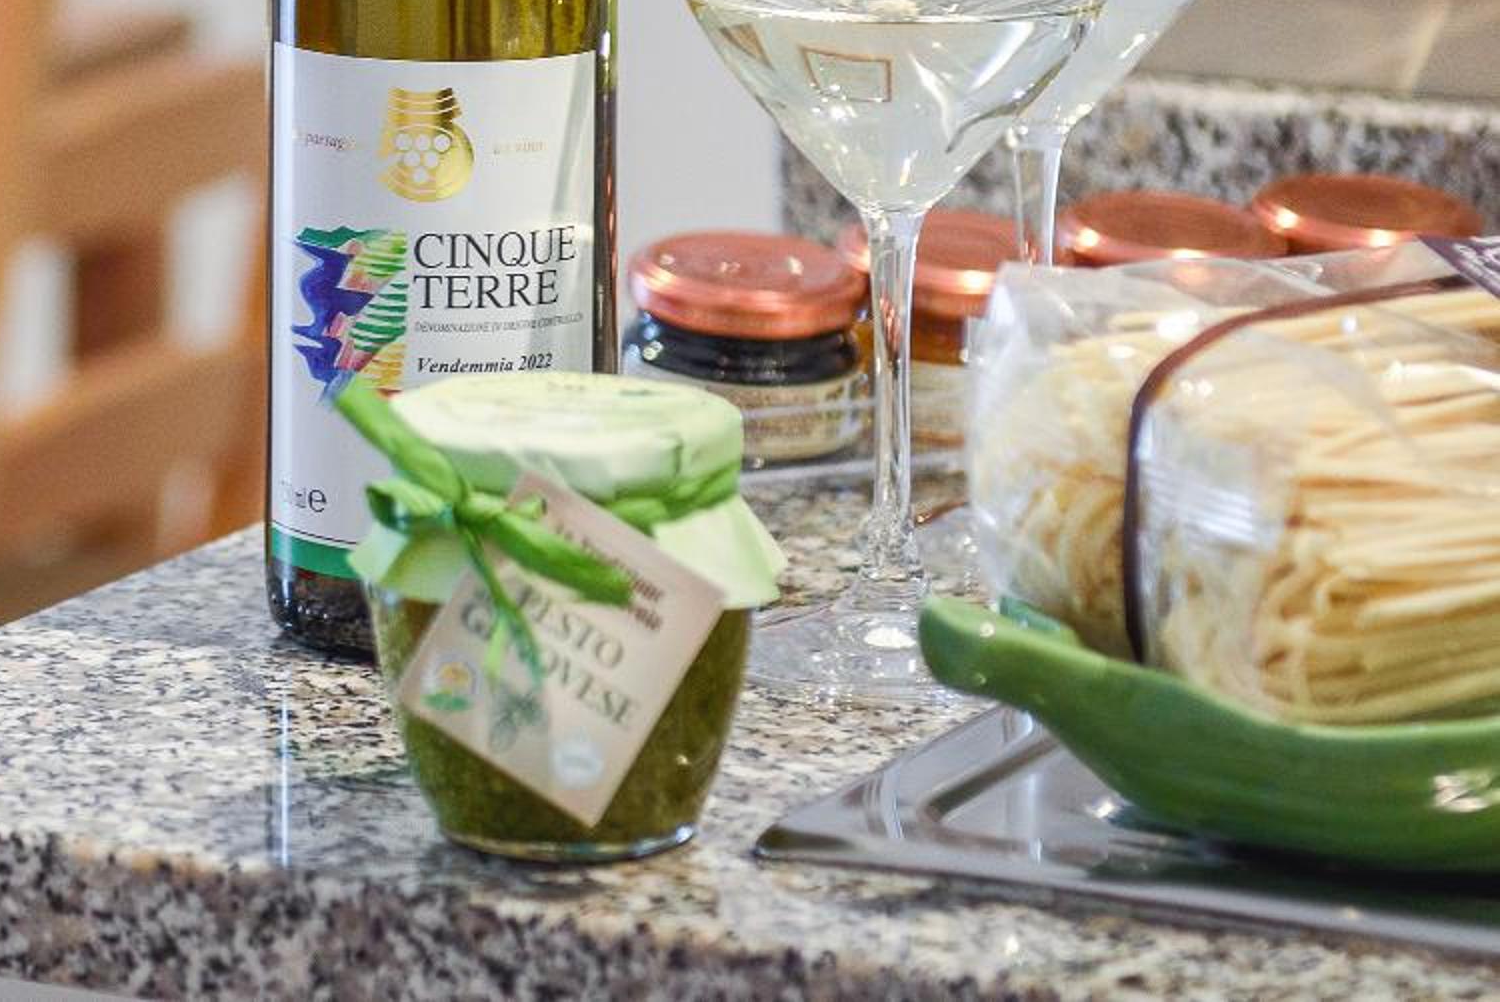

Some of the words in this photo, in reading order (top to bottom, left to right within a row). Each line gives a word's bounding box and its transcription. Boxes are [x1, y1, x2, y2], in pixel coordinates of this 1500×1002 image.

[413, 225, 577, 269] CINQUE
[413, 269, 559, 310] TERRE
[417, 357, 513, 373] Vendemmia
[518, 353, 553, 370] 2022
[517, 584, 624, 670] PESTO
